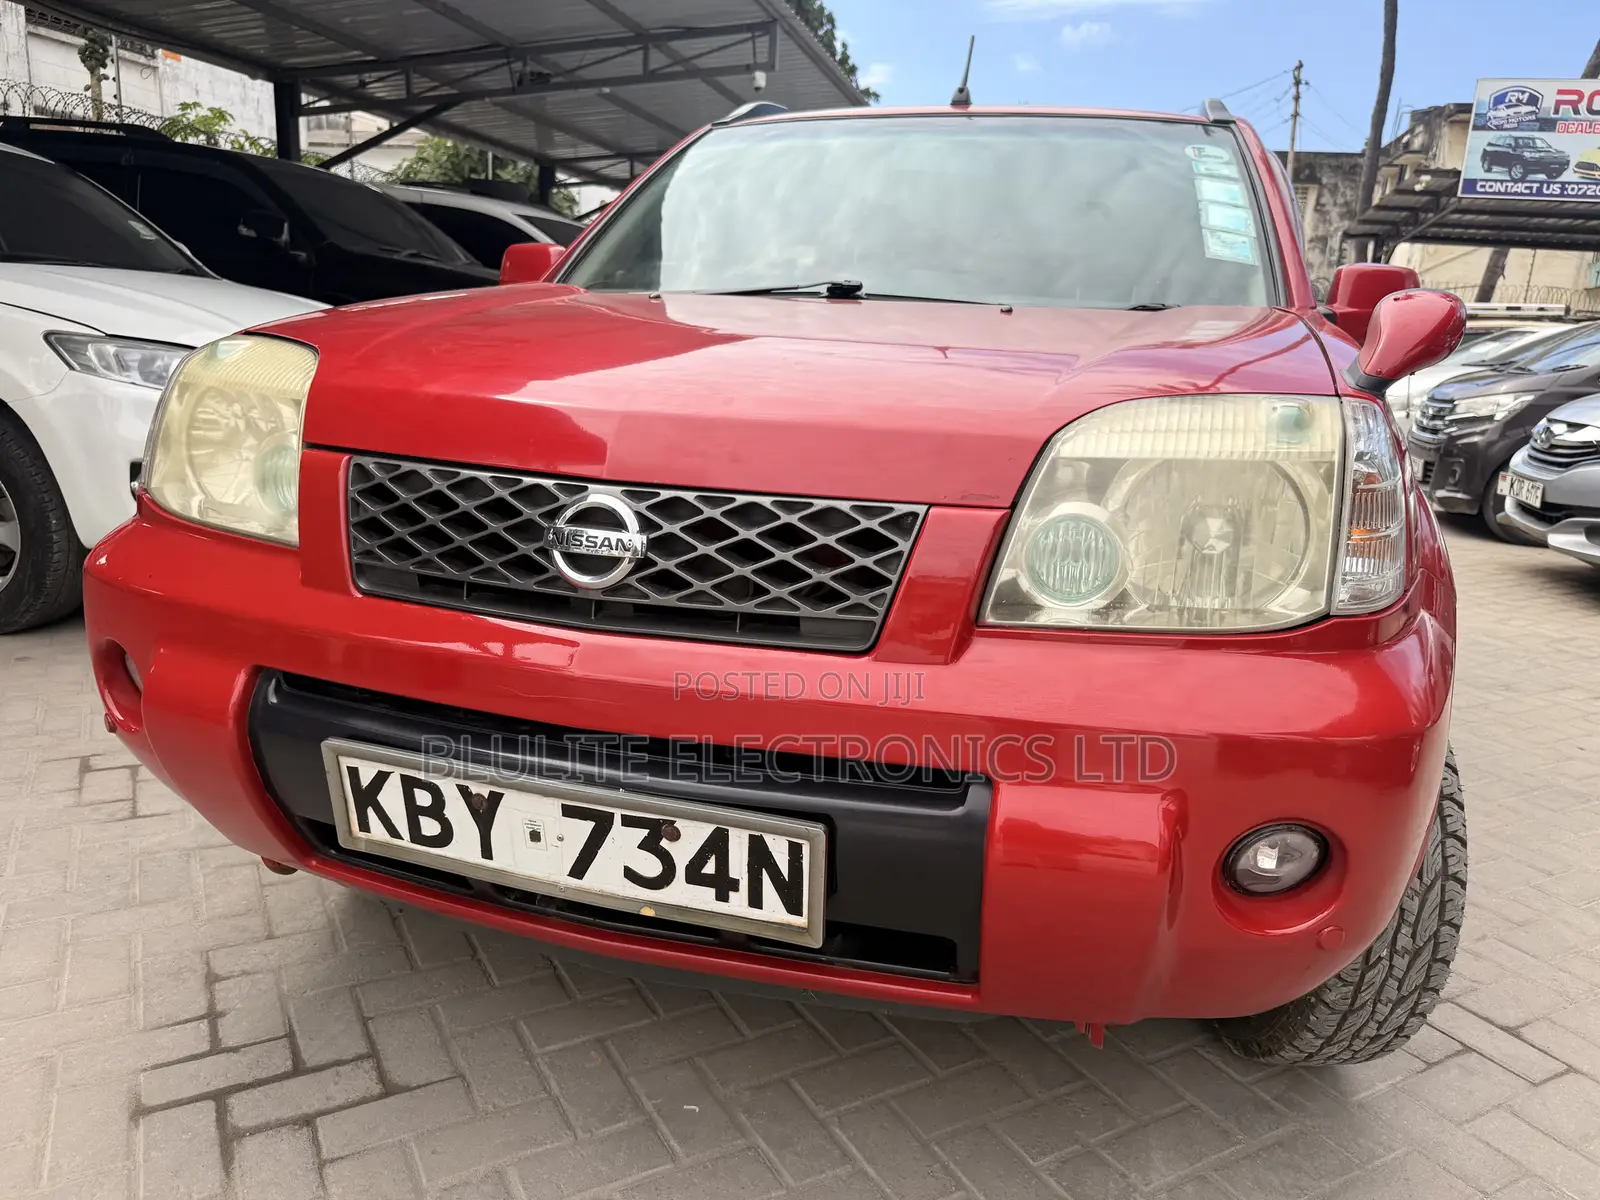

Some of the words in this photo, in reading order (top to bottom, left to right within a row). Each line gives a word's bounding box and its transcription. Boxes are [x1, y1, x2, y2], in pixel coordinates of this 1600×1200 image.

[1505, 91, 1530, 103] RM
[1476, 180, 1540, 194] CONTACT
[1542, 183, 1562, 195] US
[550, 530, 632, 552] NISSAN
[345, 765, 505, 861] KBY
[560, 802, 806, 919] 734N
